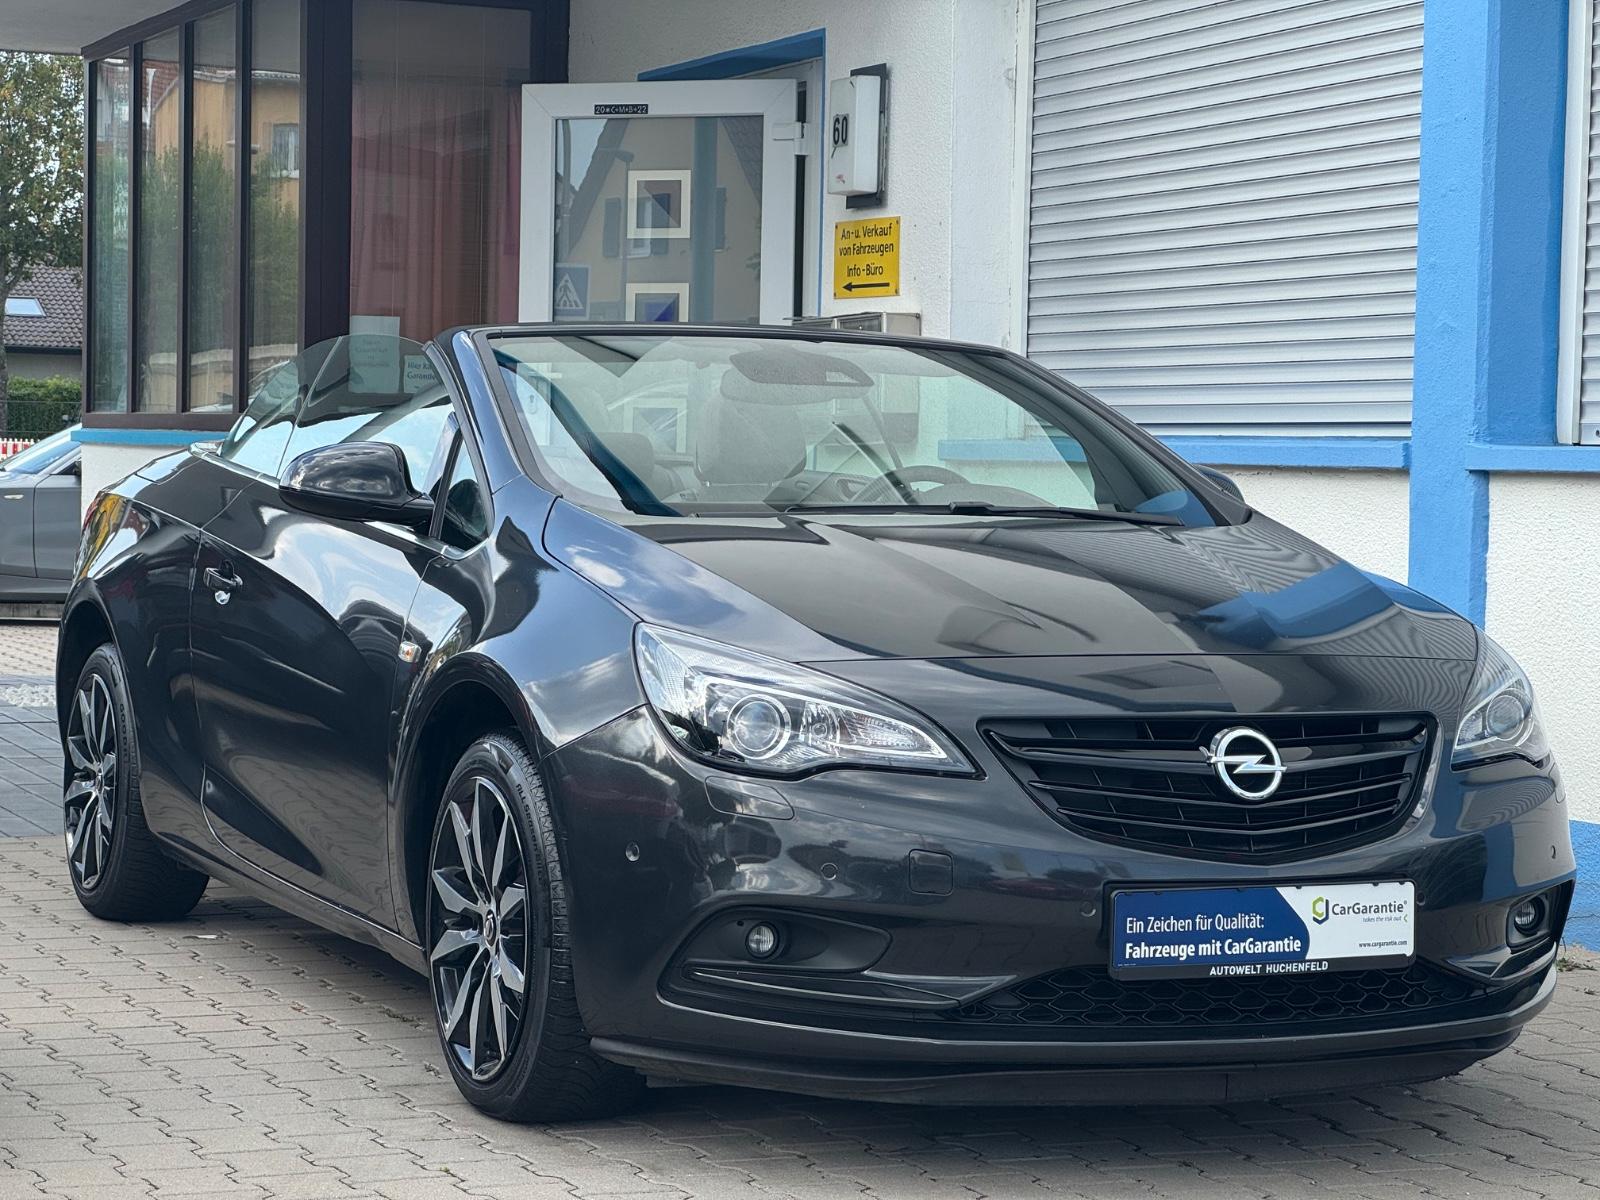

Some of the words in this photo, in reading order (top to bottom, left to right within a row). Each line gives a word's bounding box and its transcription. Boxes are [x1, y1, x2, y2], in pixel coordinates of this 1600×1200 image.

[833, 116, 848, 146] 60
[862, 223, 892, 238] Verkauf
[839, 246, 851, 256] von
[852, 242, 894, 257] Fahrzeugen
[1331, 901, 1404, 916] CarGarantie
[1126, 917, 1144, 934] Ein
[1147, 915, 1193, 933] Zeichen
[1195, 914, 1213, 931] für
[1215, 913, 1265, 931] Qualität:
[1125, 941, 1196, 961] Fahrzeuge
[1198, 939, 1222, 956] mit
[1224, 936, 1302, 955] CarGarantie
[1359, 940, 1408, 949] www.cargarantie.com
[1209, 964, 1262, 976] AUTOWELT
[1265, 961, 1329, 974] HUCHENFELD
